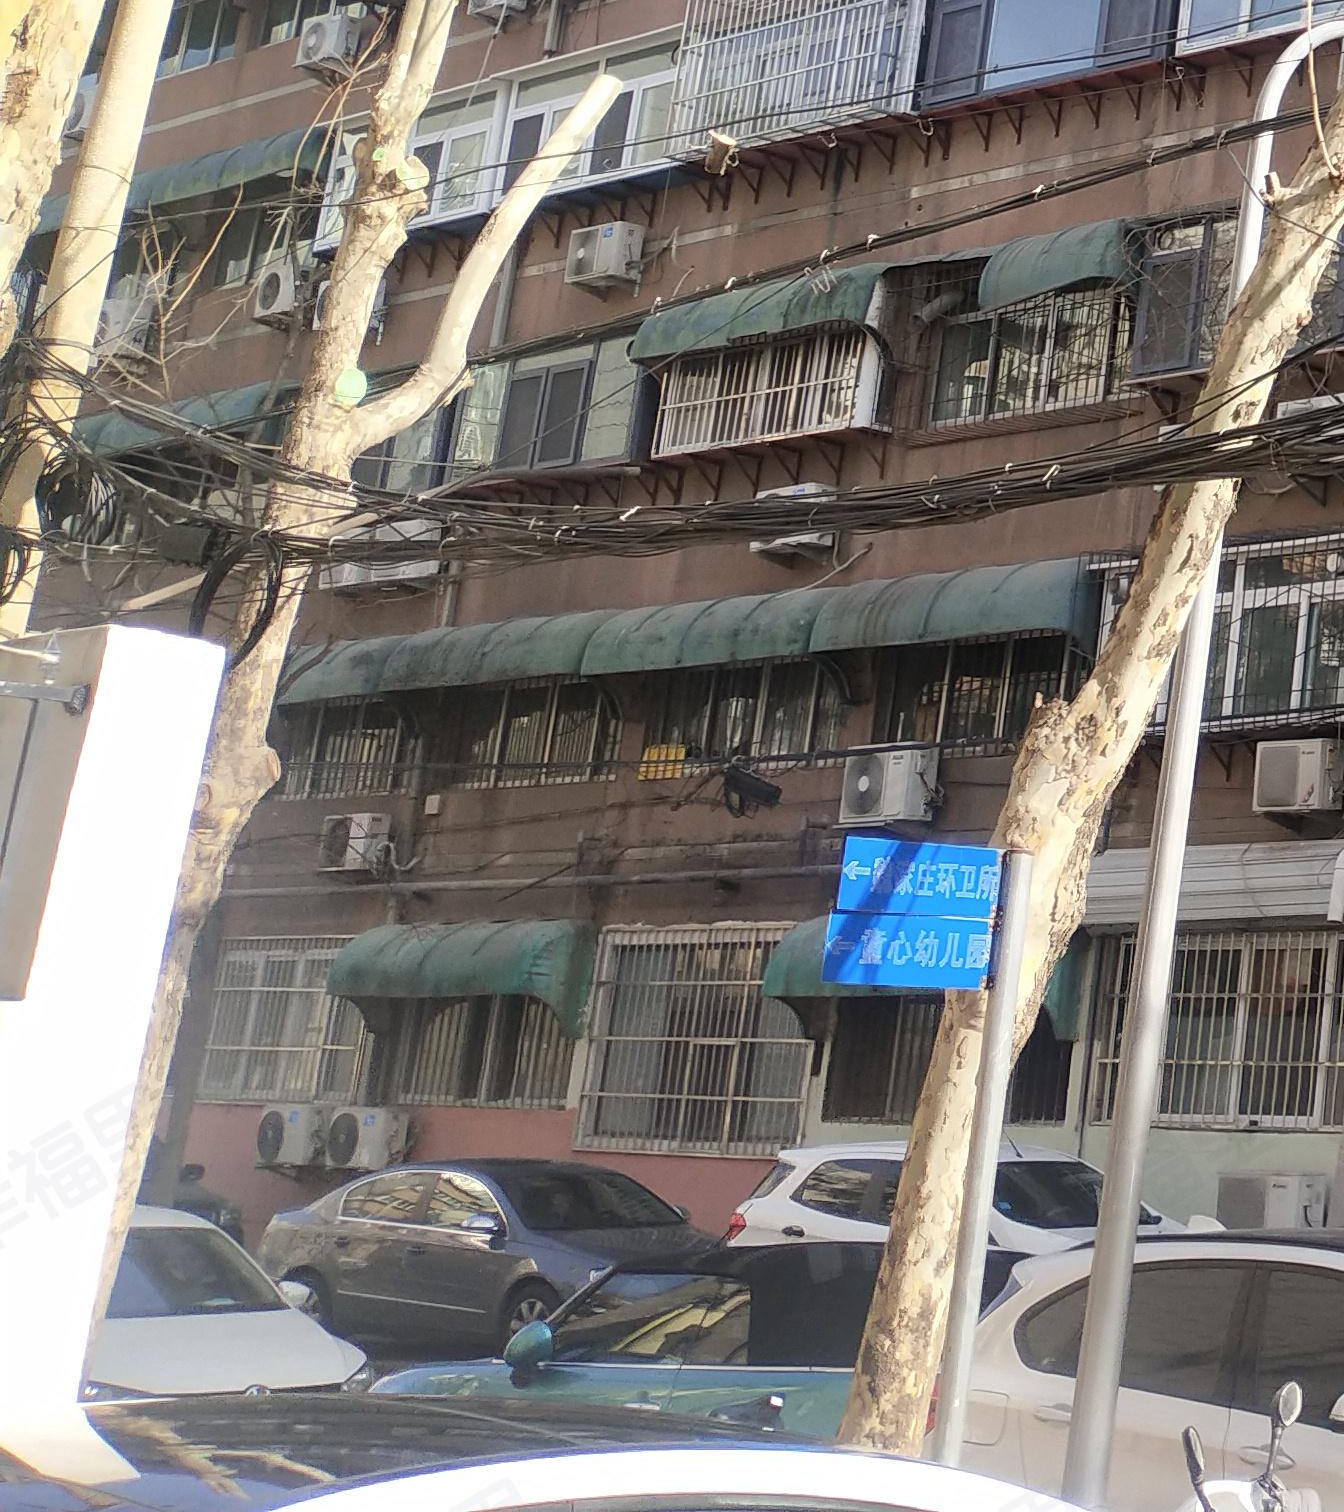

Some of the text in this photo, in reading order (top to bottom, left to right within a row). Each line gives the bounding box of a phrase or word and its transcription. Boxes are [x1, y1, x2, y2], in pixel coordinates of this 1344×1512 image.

[859, 928, 992, 968] 童心幼儿园
